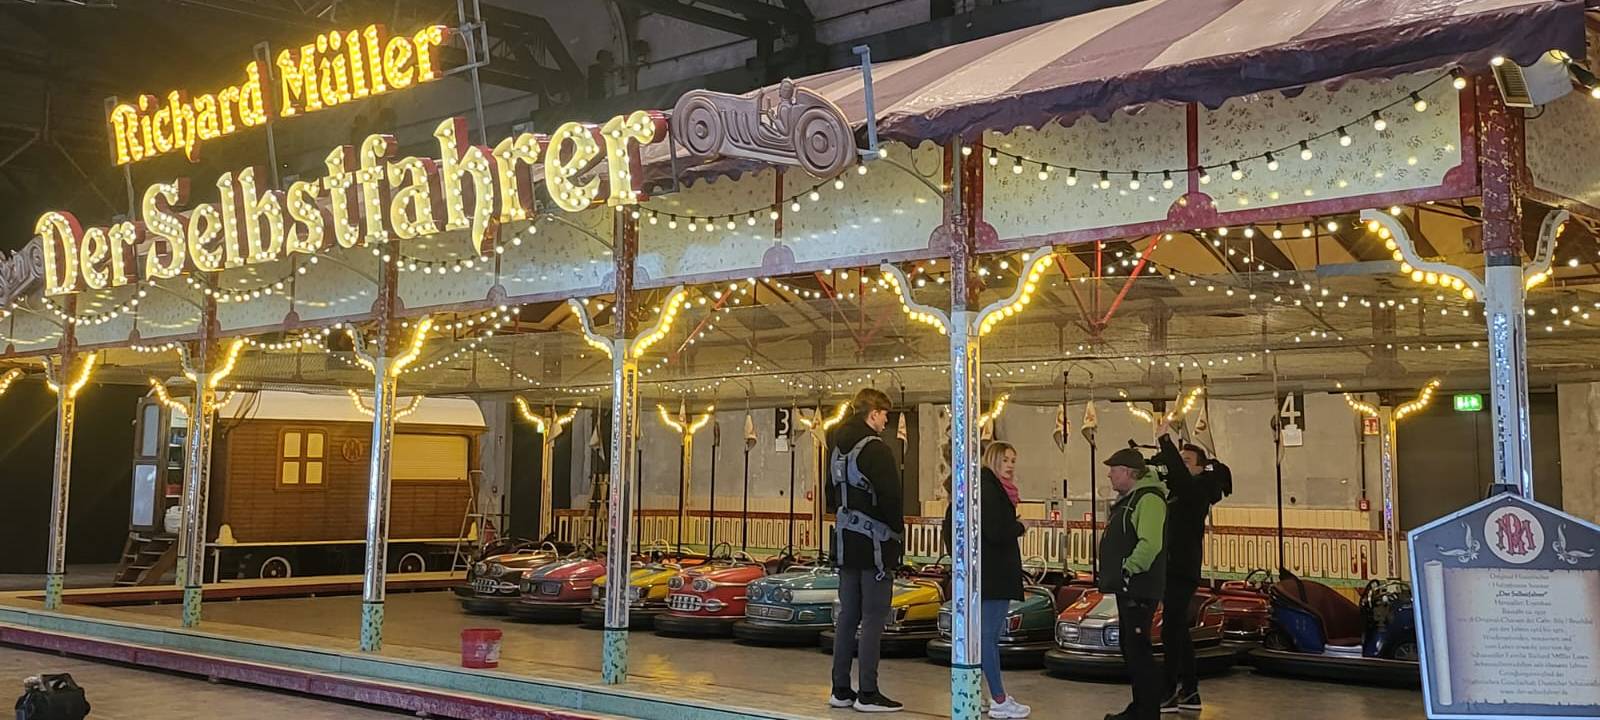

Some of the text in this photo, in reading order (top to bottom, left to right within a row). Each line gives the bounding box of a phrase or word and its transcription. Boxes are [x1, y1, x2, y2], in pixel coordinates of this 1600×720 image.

[110, 24, 446, 165] Richard Müller
[35, 109, 657, 295] Der Selbstfahrer
[779, 408, 790, 434] 3
[1280, 391, 1301, 425] 4
